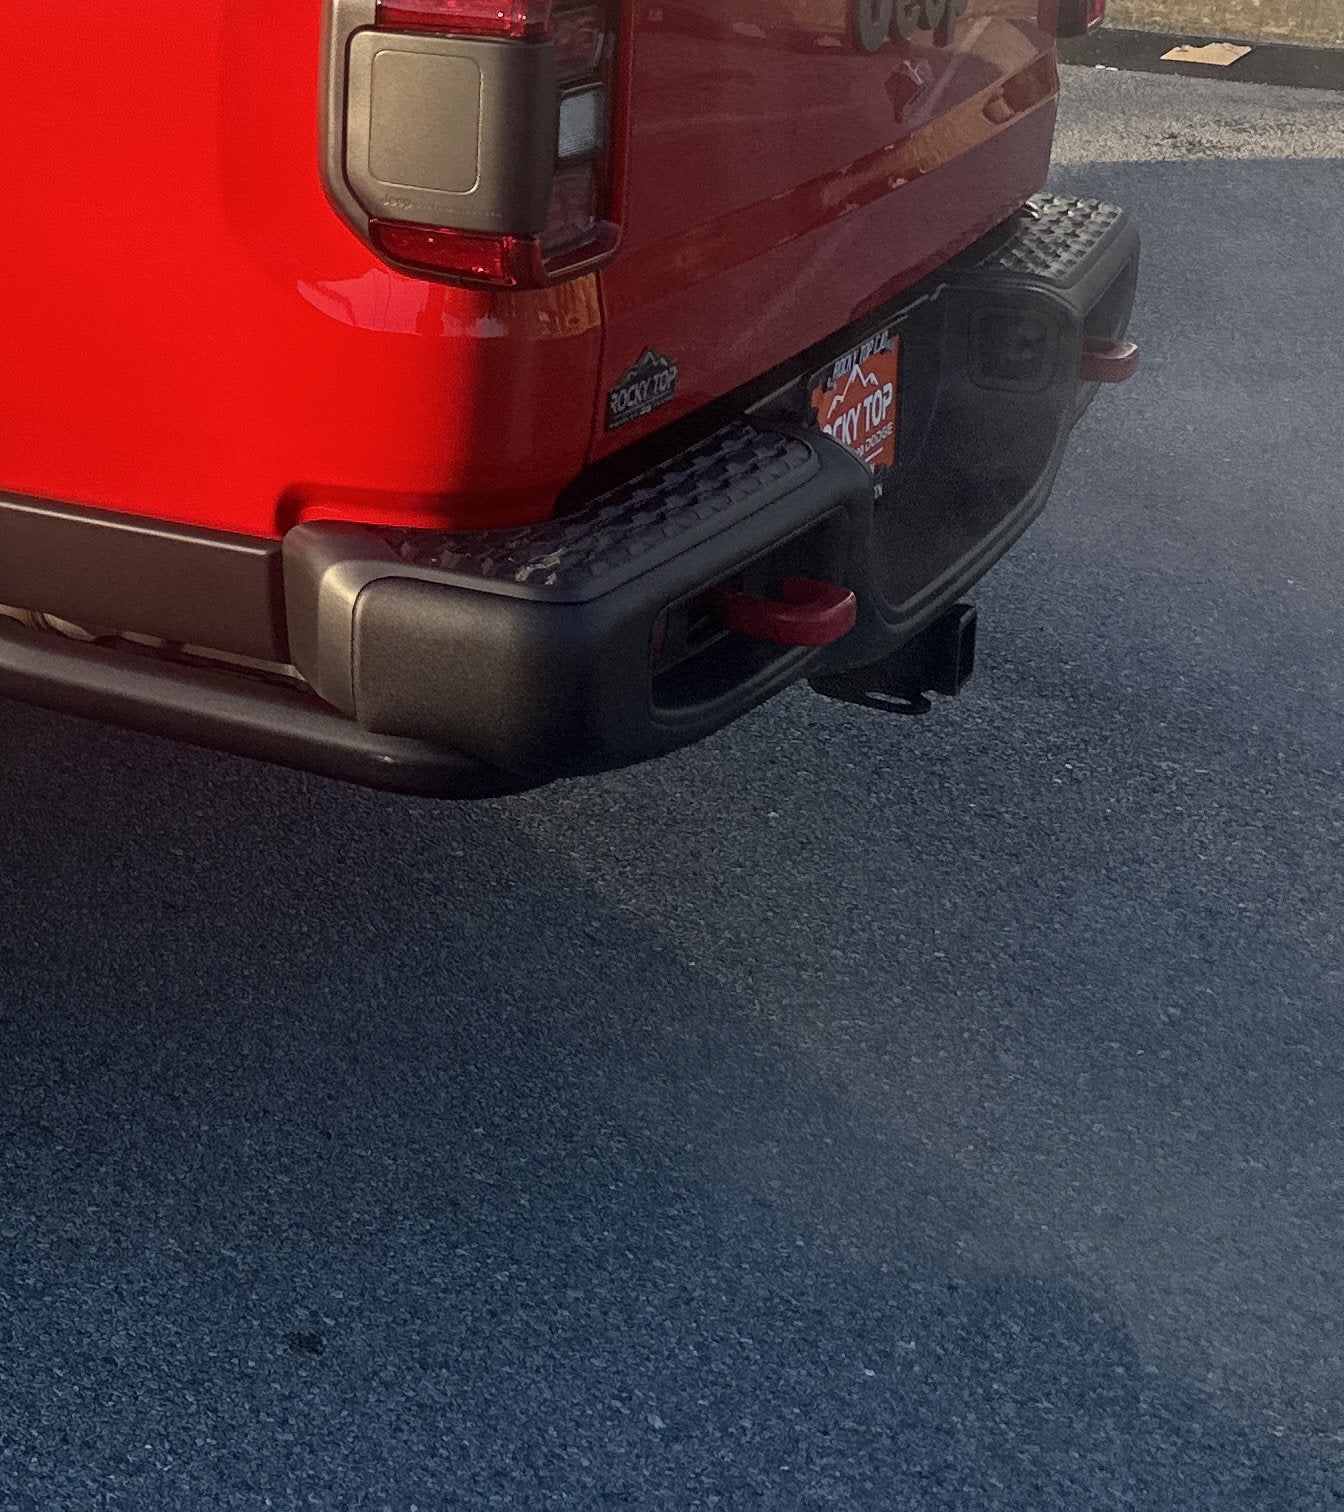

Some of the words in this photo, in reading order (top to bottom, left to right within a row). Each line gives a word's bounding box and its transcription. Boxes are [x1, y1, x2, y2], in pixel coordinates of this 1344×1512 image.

[609, 377, 652, 414] ROCKY
[653, 365, 678, 396] TOP
[863, 382, 893, 433] TOP
